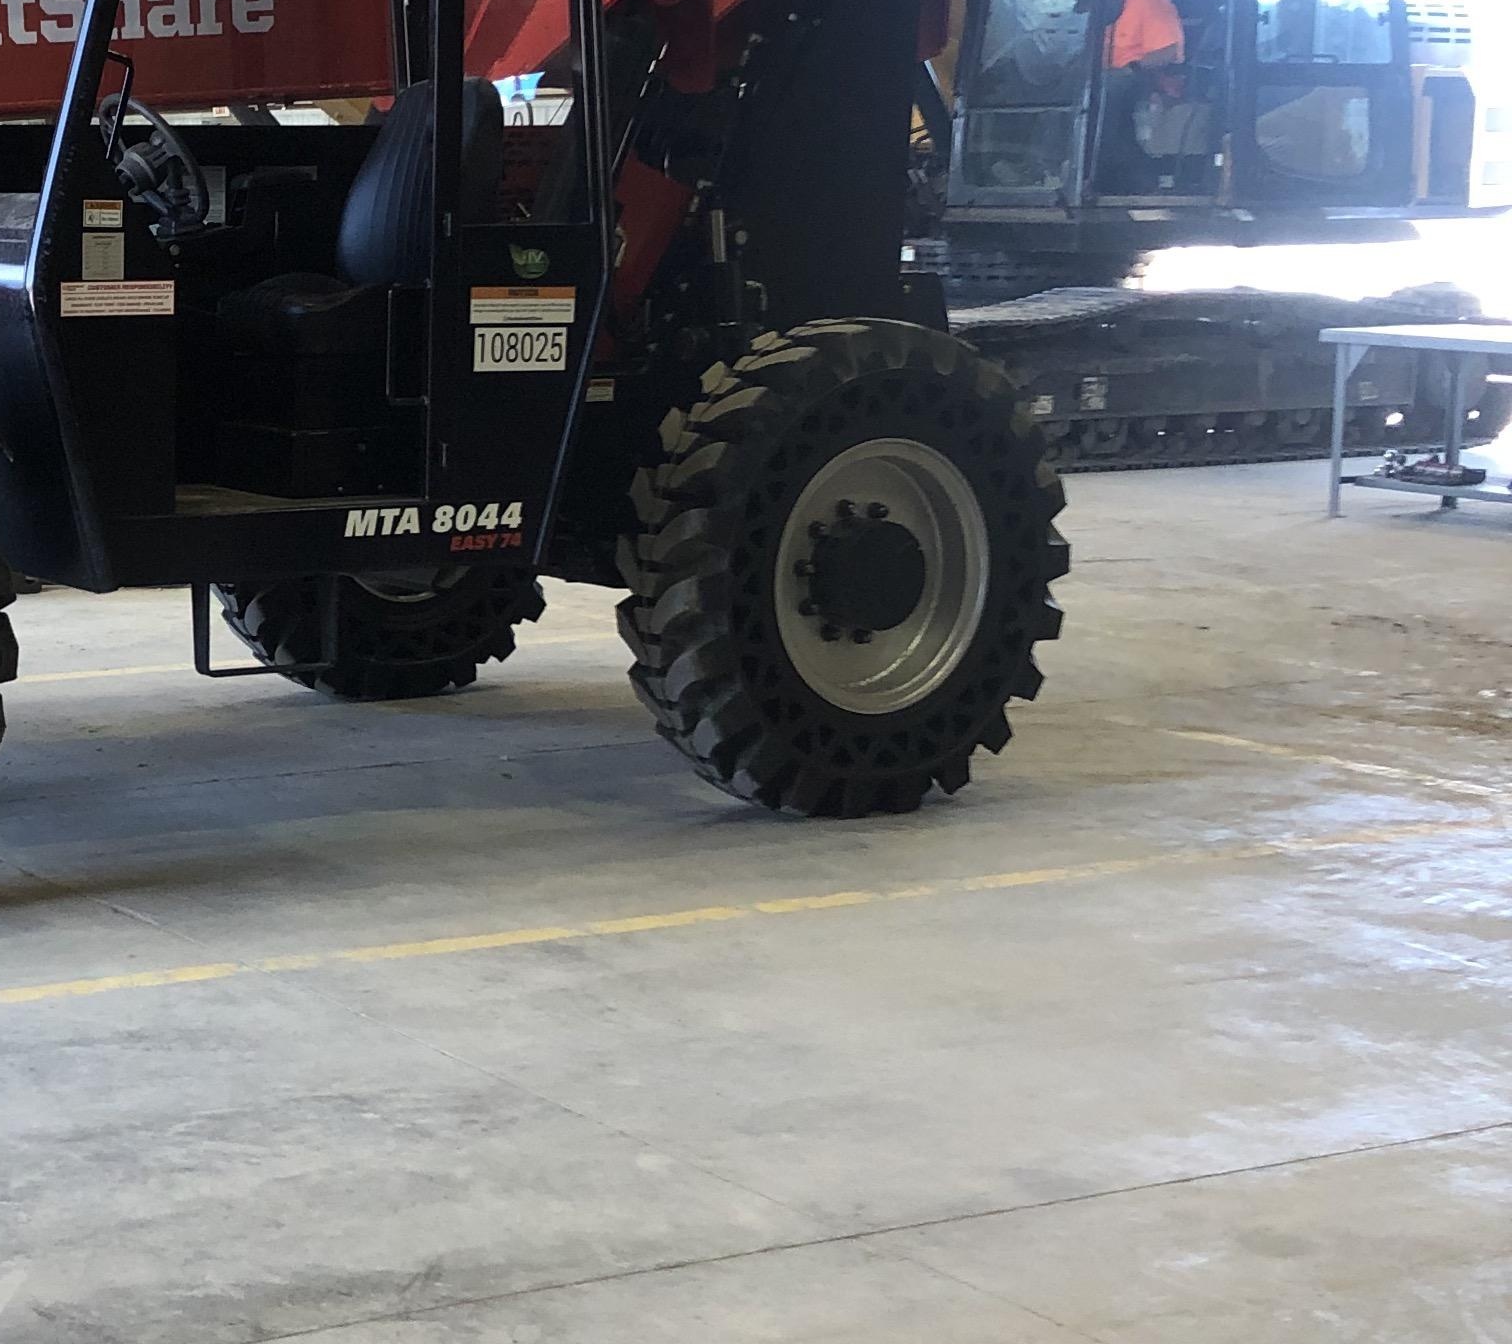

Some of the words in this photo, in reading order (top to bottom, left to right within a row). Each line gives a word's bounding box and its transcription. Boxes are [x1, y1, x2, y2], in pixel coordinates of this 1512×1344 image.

[477, 332, 564, 363] 108025
[344, 507, 421, 538] MTA
[432, 502, 523, 534] 8044
[449, 535, 497, 553] EASY
